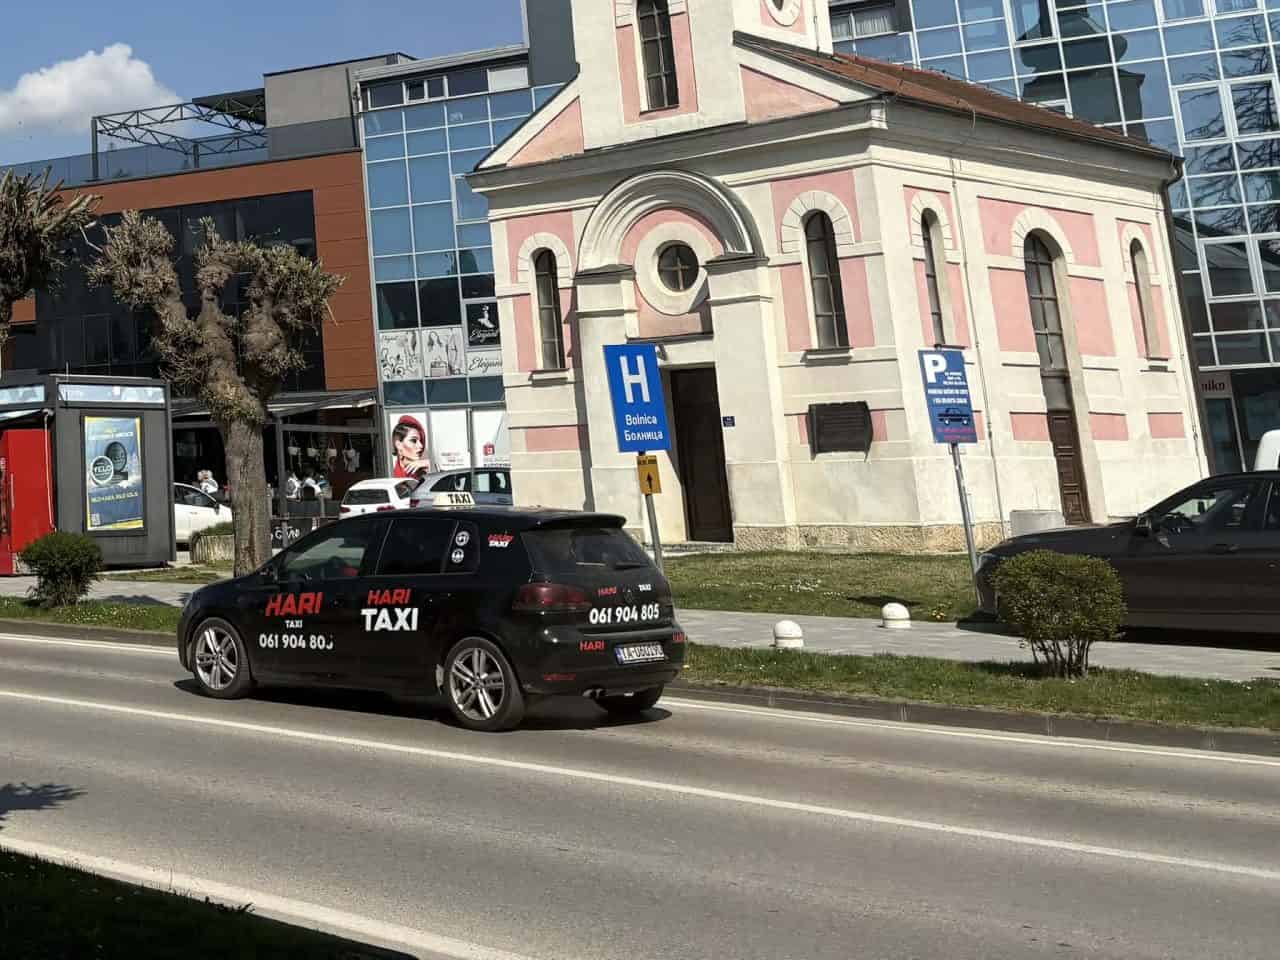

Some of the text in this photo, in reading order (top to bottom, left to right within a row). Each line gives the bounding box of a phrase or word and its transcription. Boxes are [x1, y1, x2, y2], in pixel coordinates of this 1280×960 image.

[923, 354, 947, 383] P
[620, 355, 650, 403] H
[625, 414, 657, 425] Bolnica
[624, 430, 663, 441] Болница
[448, 494, 472, 504] TAXI
[265, 592, 323, 616] HARI
[368, 589, 411, 605] HARI
[361, 607, 418, 631] TAXI
[589, 603, 659, 624] 061 904 805
[285, 620, 303, 628] TAXI
[259, 634, 278, 648] 061
[282, 635, 306, 649] 904
[580, 640, 605, 651] HARI
